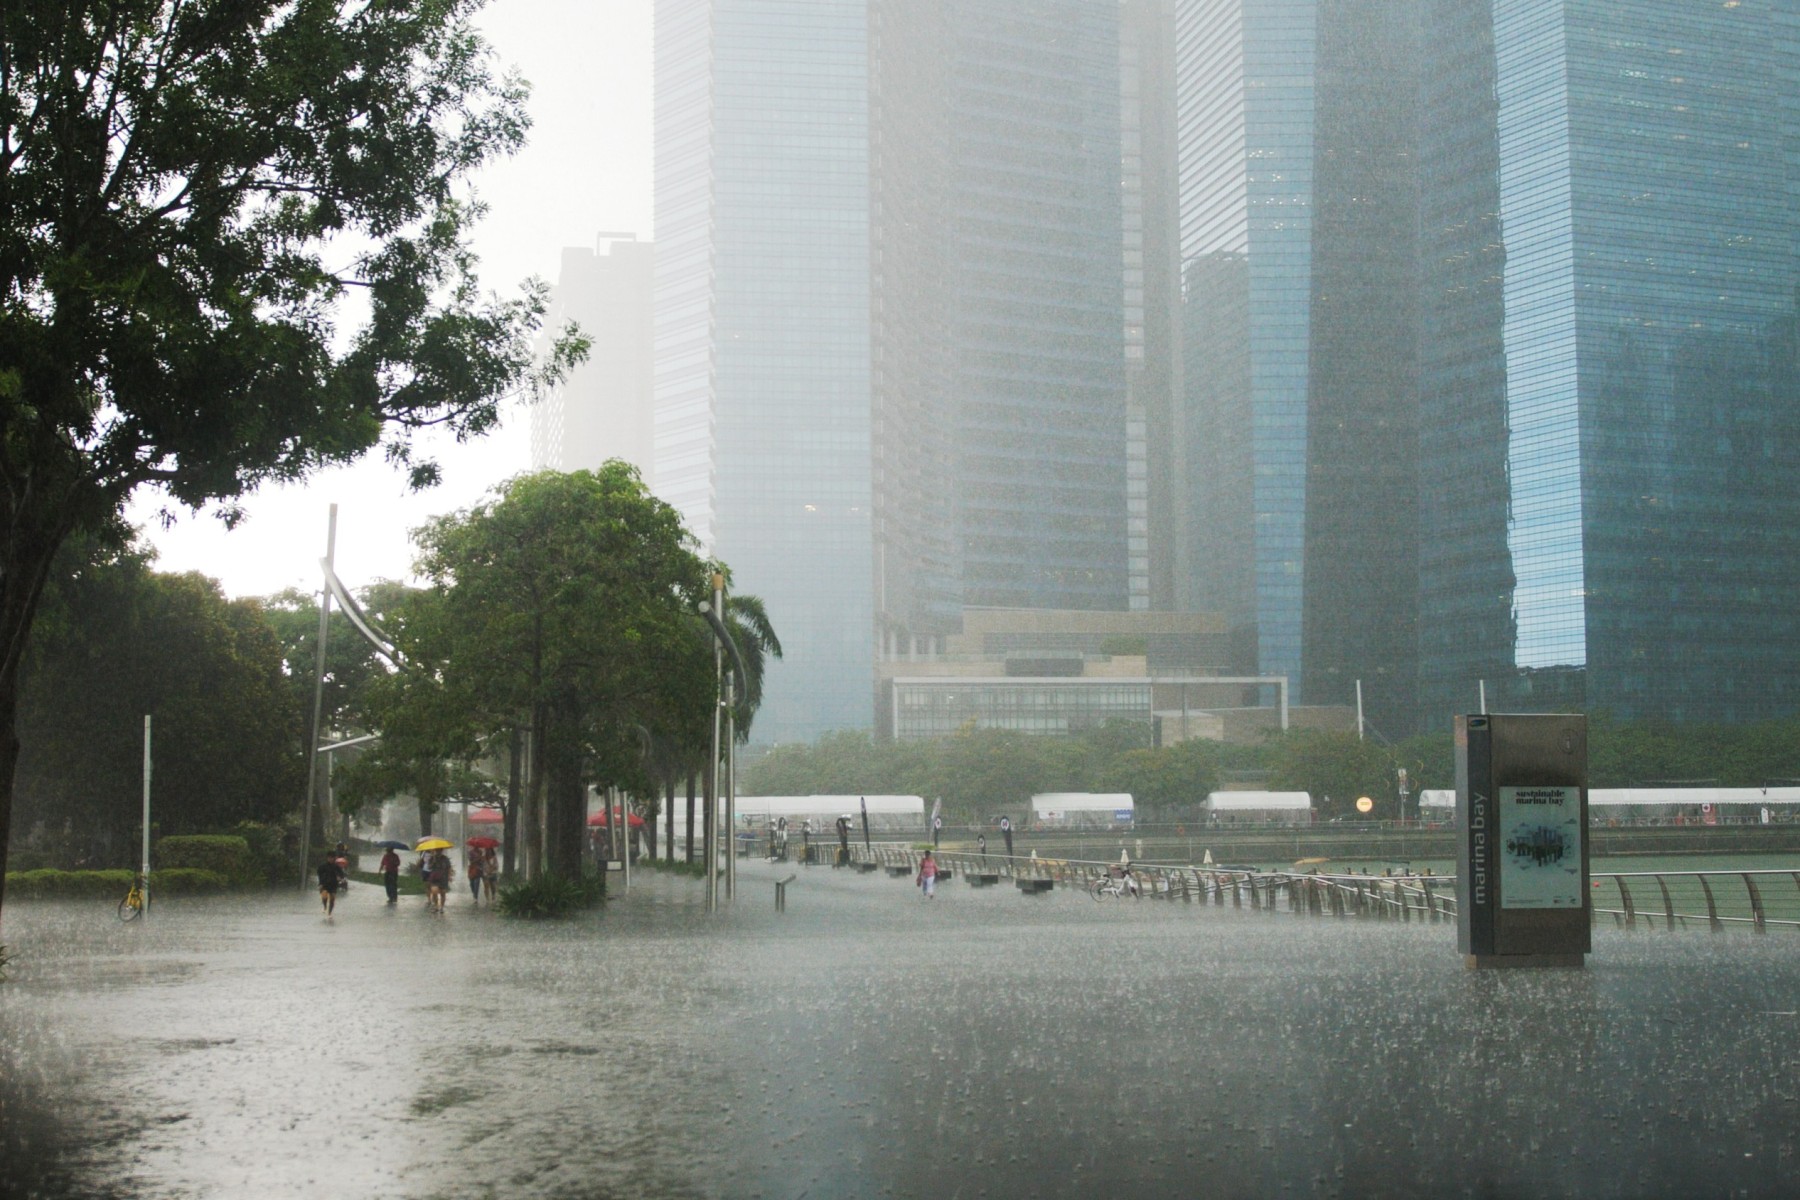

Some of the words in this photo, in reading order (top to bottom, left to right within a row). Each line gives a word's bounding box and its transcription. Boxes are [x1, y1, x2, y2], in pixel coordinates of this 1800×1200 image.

[1516, 790, 1565, 798] sustainable
[1516, 797, 1546, 805] marina
[1549, 797, 1565, 806] bay
[1471, 792, 1487, 829] bay
[1472, 833, 1485, 904] marina
